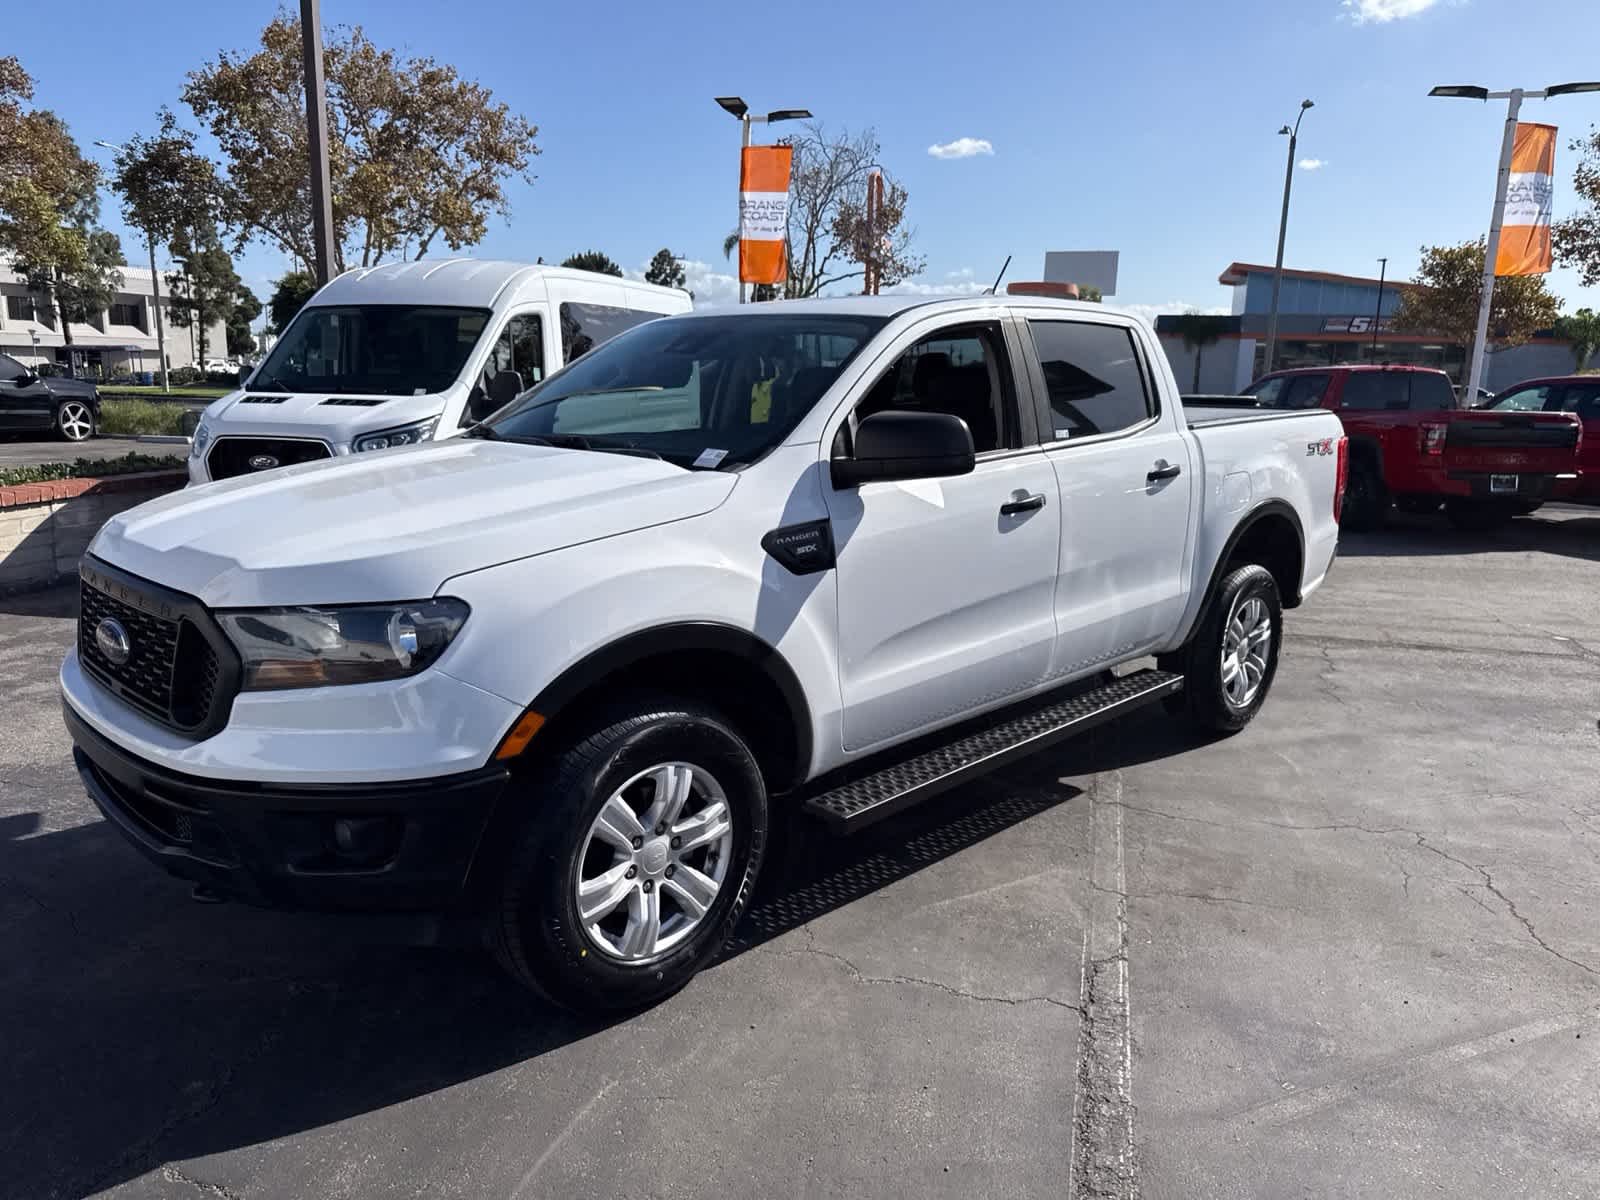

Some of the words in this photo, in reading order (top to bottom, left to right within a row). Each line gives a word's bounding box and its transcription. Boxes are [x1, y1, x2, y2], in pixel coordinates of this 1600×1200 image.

[739, 200, 785, 211] ORANG
[742, 211, 784, 222] COAST
[776, 530, 819, 544] RANGER
